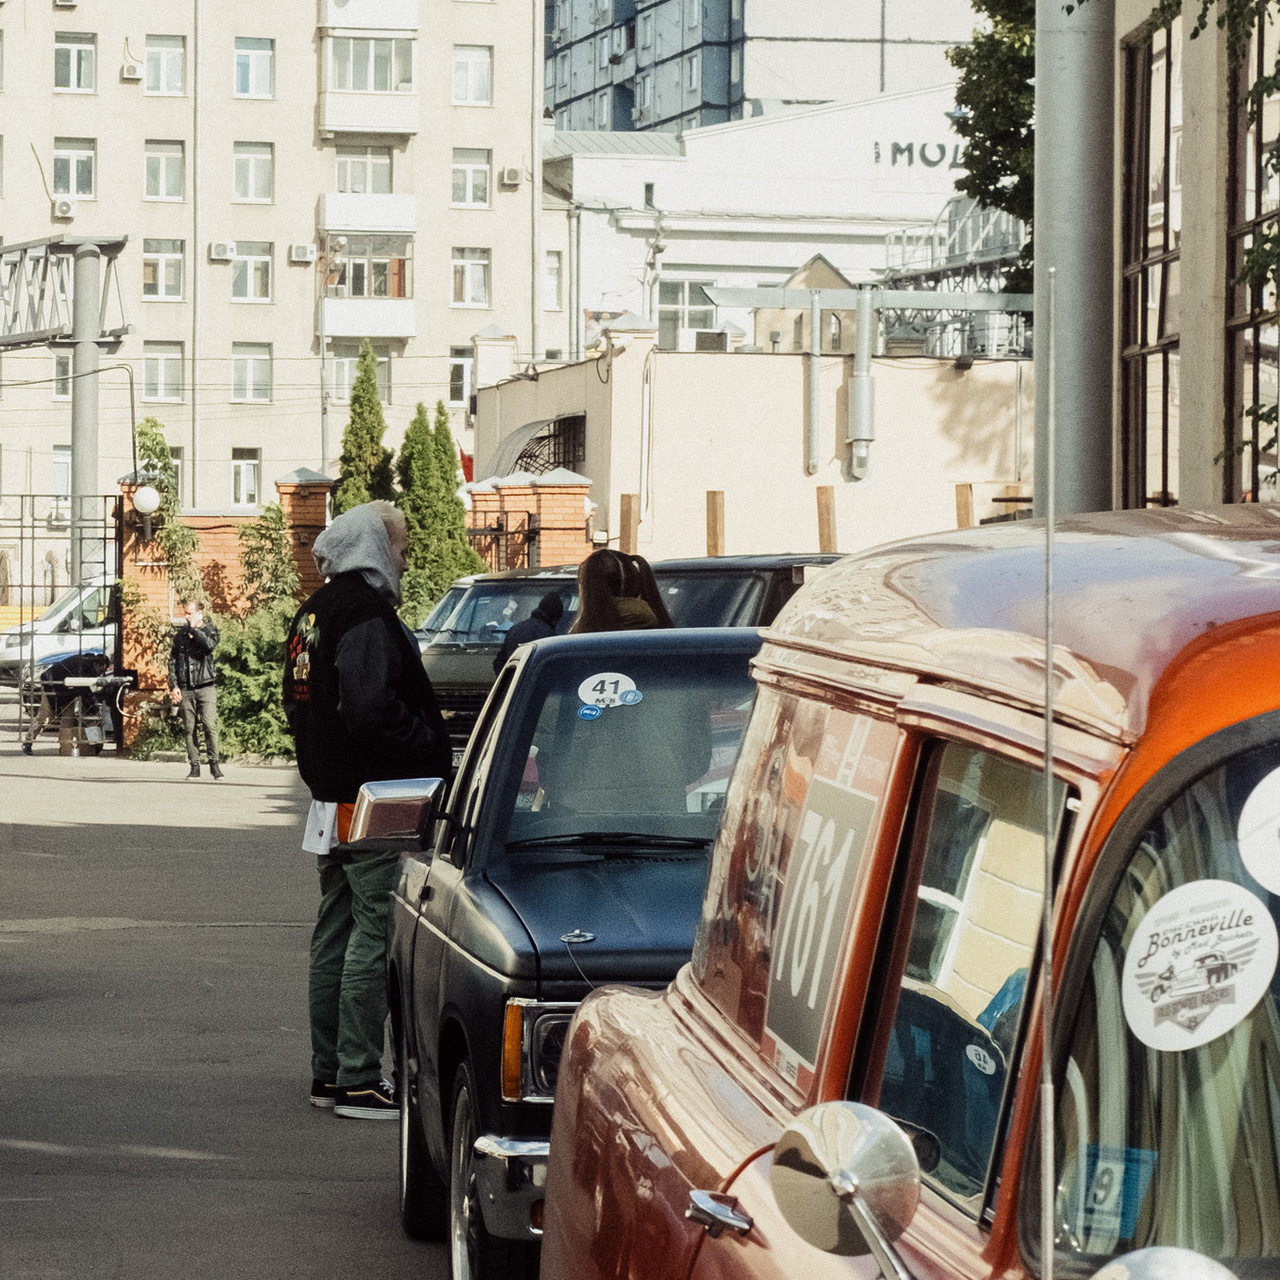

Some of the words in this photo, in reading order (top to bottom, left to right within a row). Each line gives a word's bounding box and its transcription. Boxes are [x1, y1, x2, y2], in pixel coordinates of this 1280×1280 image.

[591, 679, 620, 695] 41
[775, 809, 856, 1010] 761
[1137, 908, 1254, 969] Bonneville
